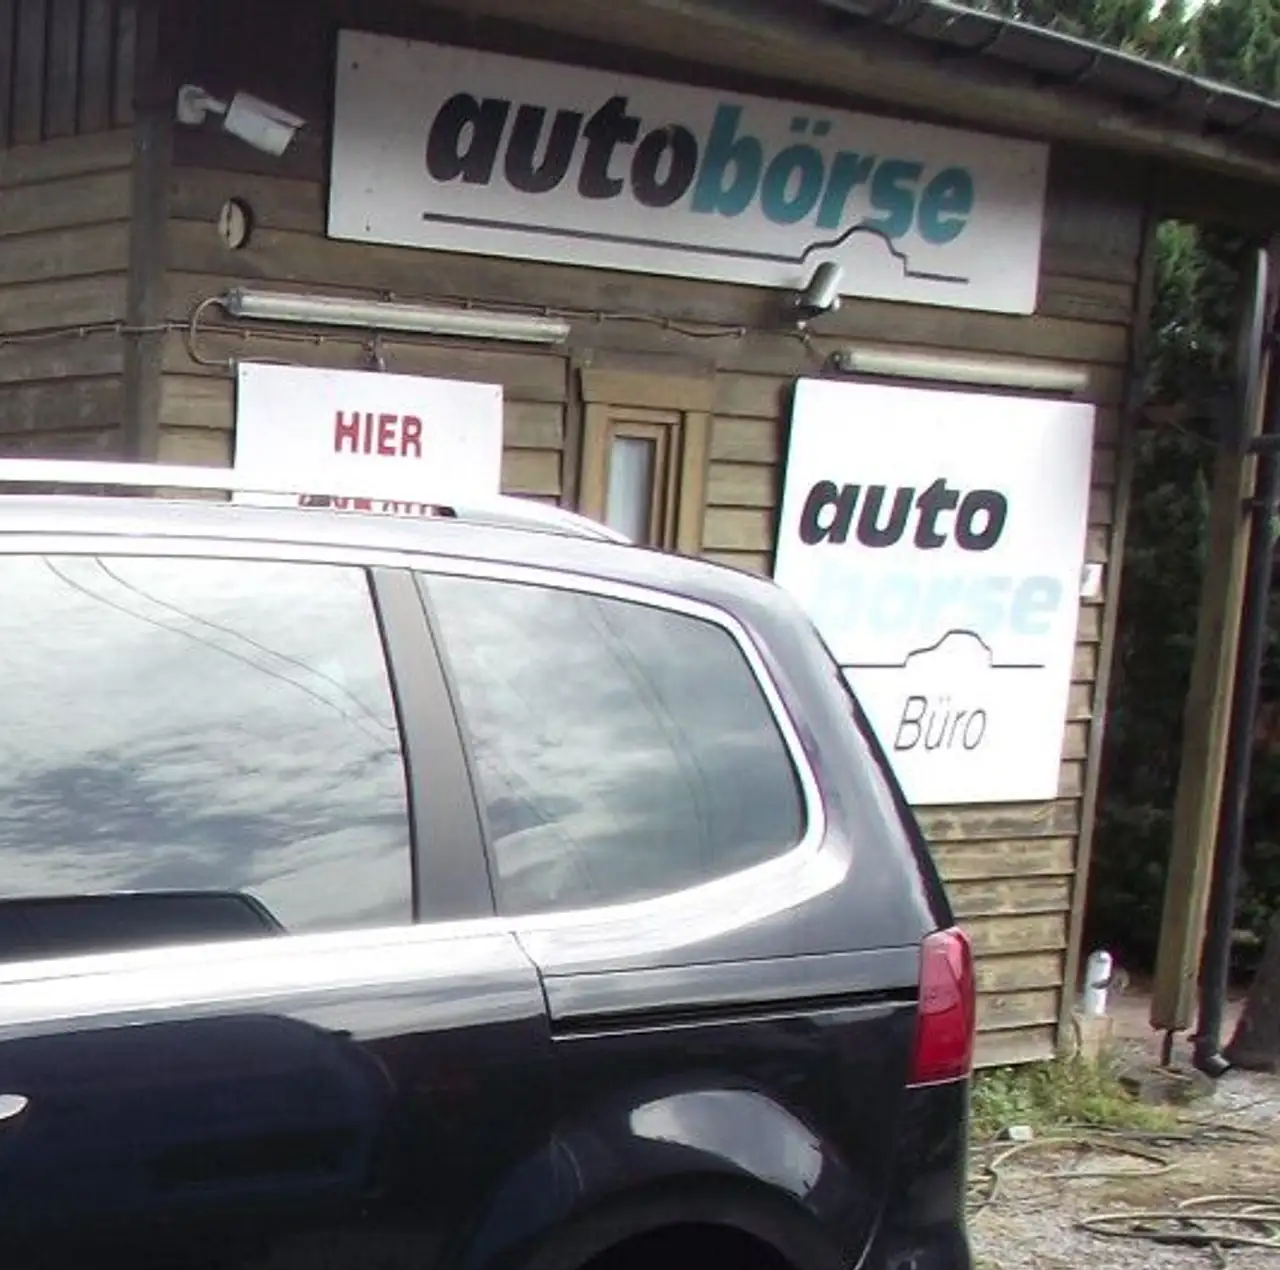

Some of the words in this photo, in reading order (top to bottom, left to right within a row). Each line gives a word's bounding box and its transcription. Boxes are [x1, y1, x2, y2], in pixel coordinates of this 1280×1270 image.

[424, 88, 975, 246] autobörse
[334, 411, 422, 457] HIER
[799, 478, 1008, 552] auto
[893, 695, 987, 752] Büro
